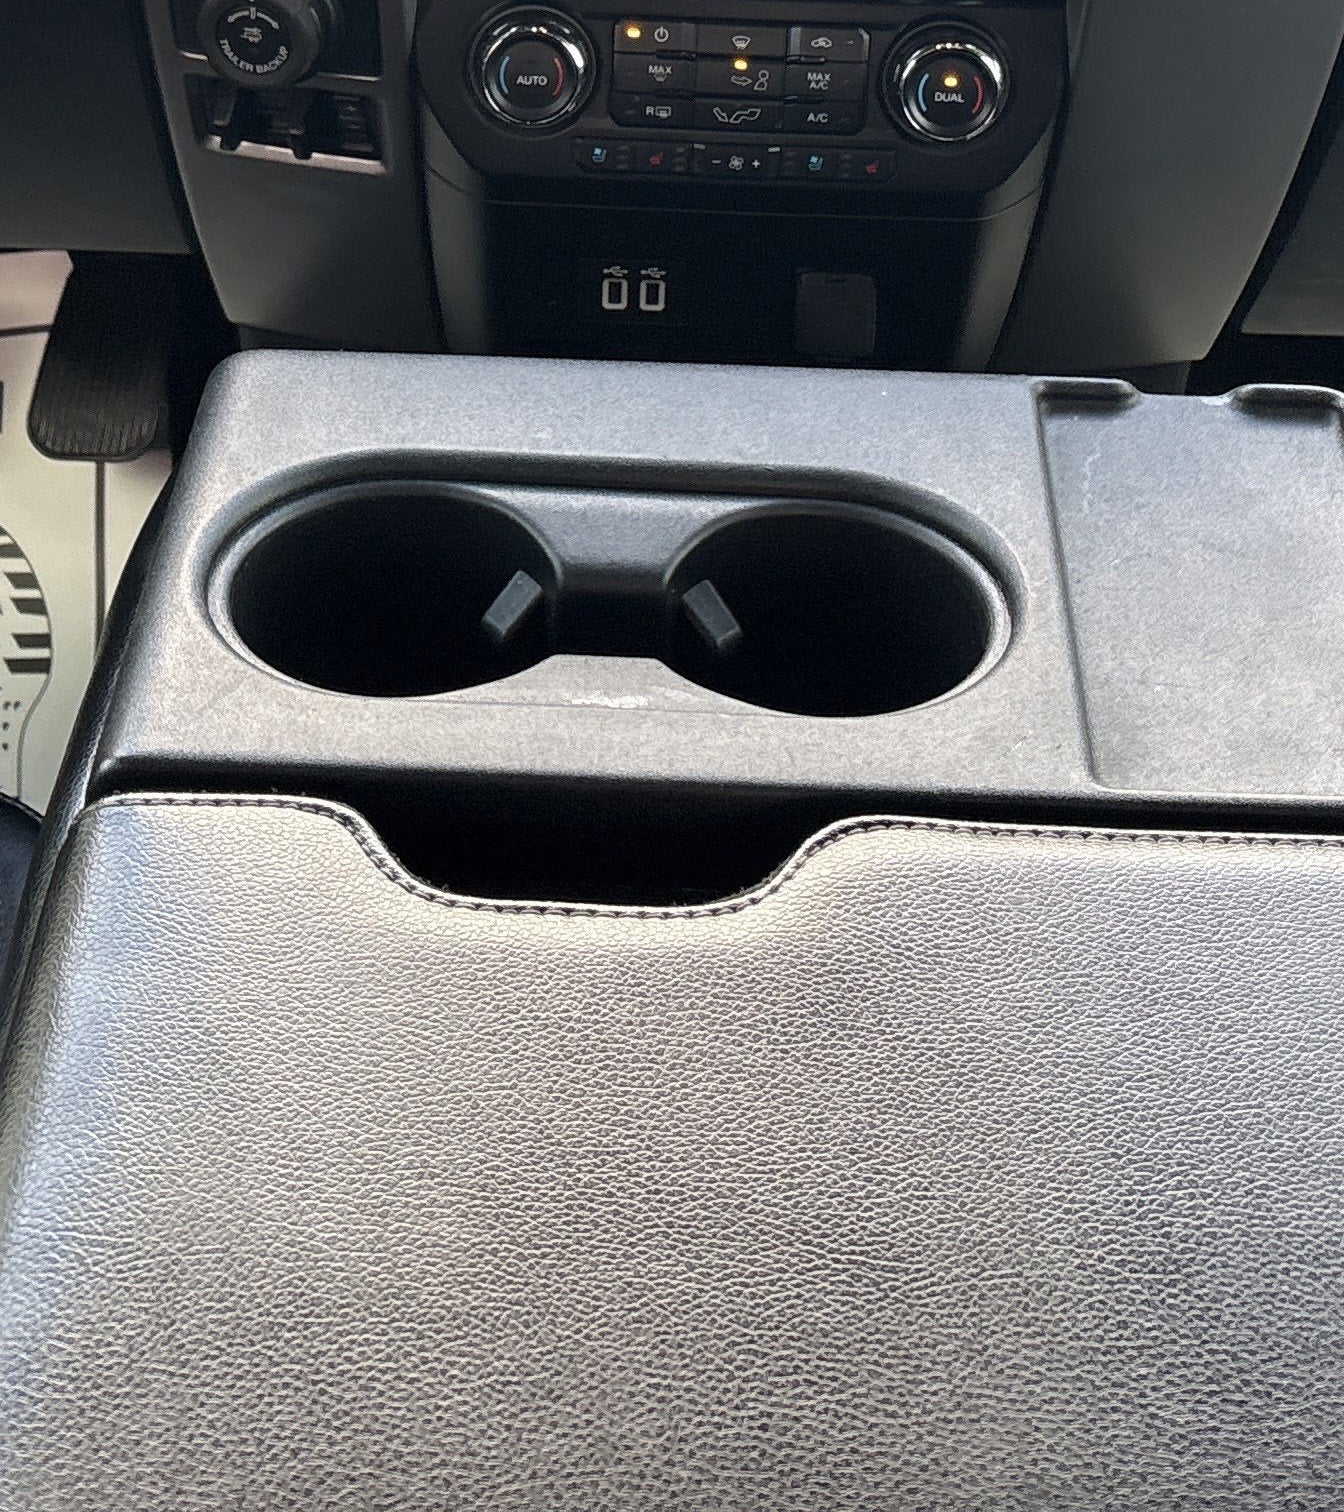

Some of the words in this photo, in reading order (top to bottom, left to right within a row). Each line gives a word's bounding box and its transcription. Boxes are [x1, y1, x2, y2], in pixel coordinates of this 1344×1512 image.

[219, 38, 253, 73] TRAILER
[255, 45, 288, 74] BACKUP
[648, 64, 672, 75] MAX
[516, 75, 548, 86] AUTO
[807, 72, 831, 82] MAX
[934, 91, 965, 104] DUAL
[807, 113, 829, 123] A/C
